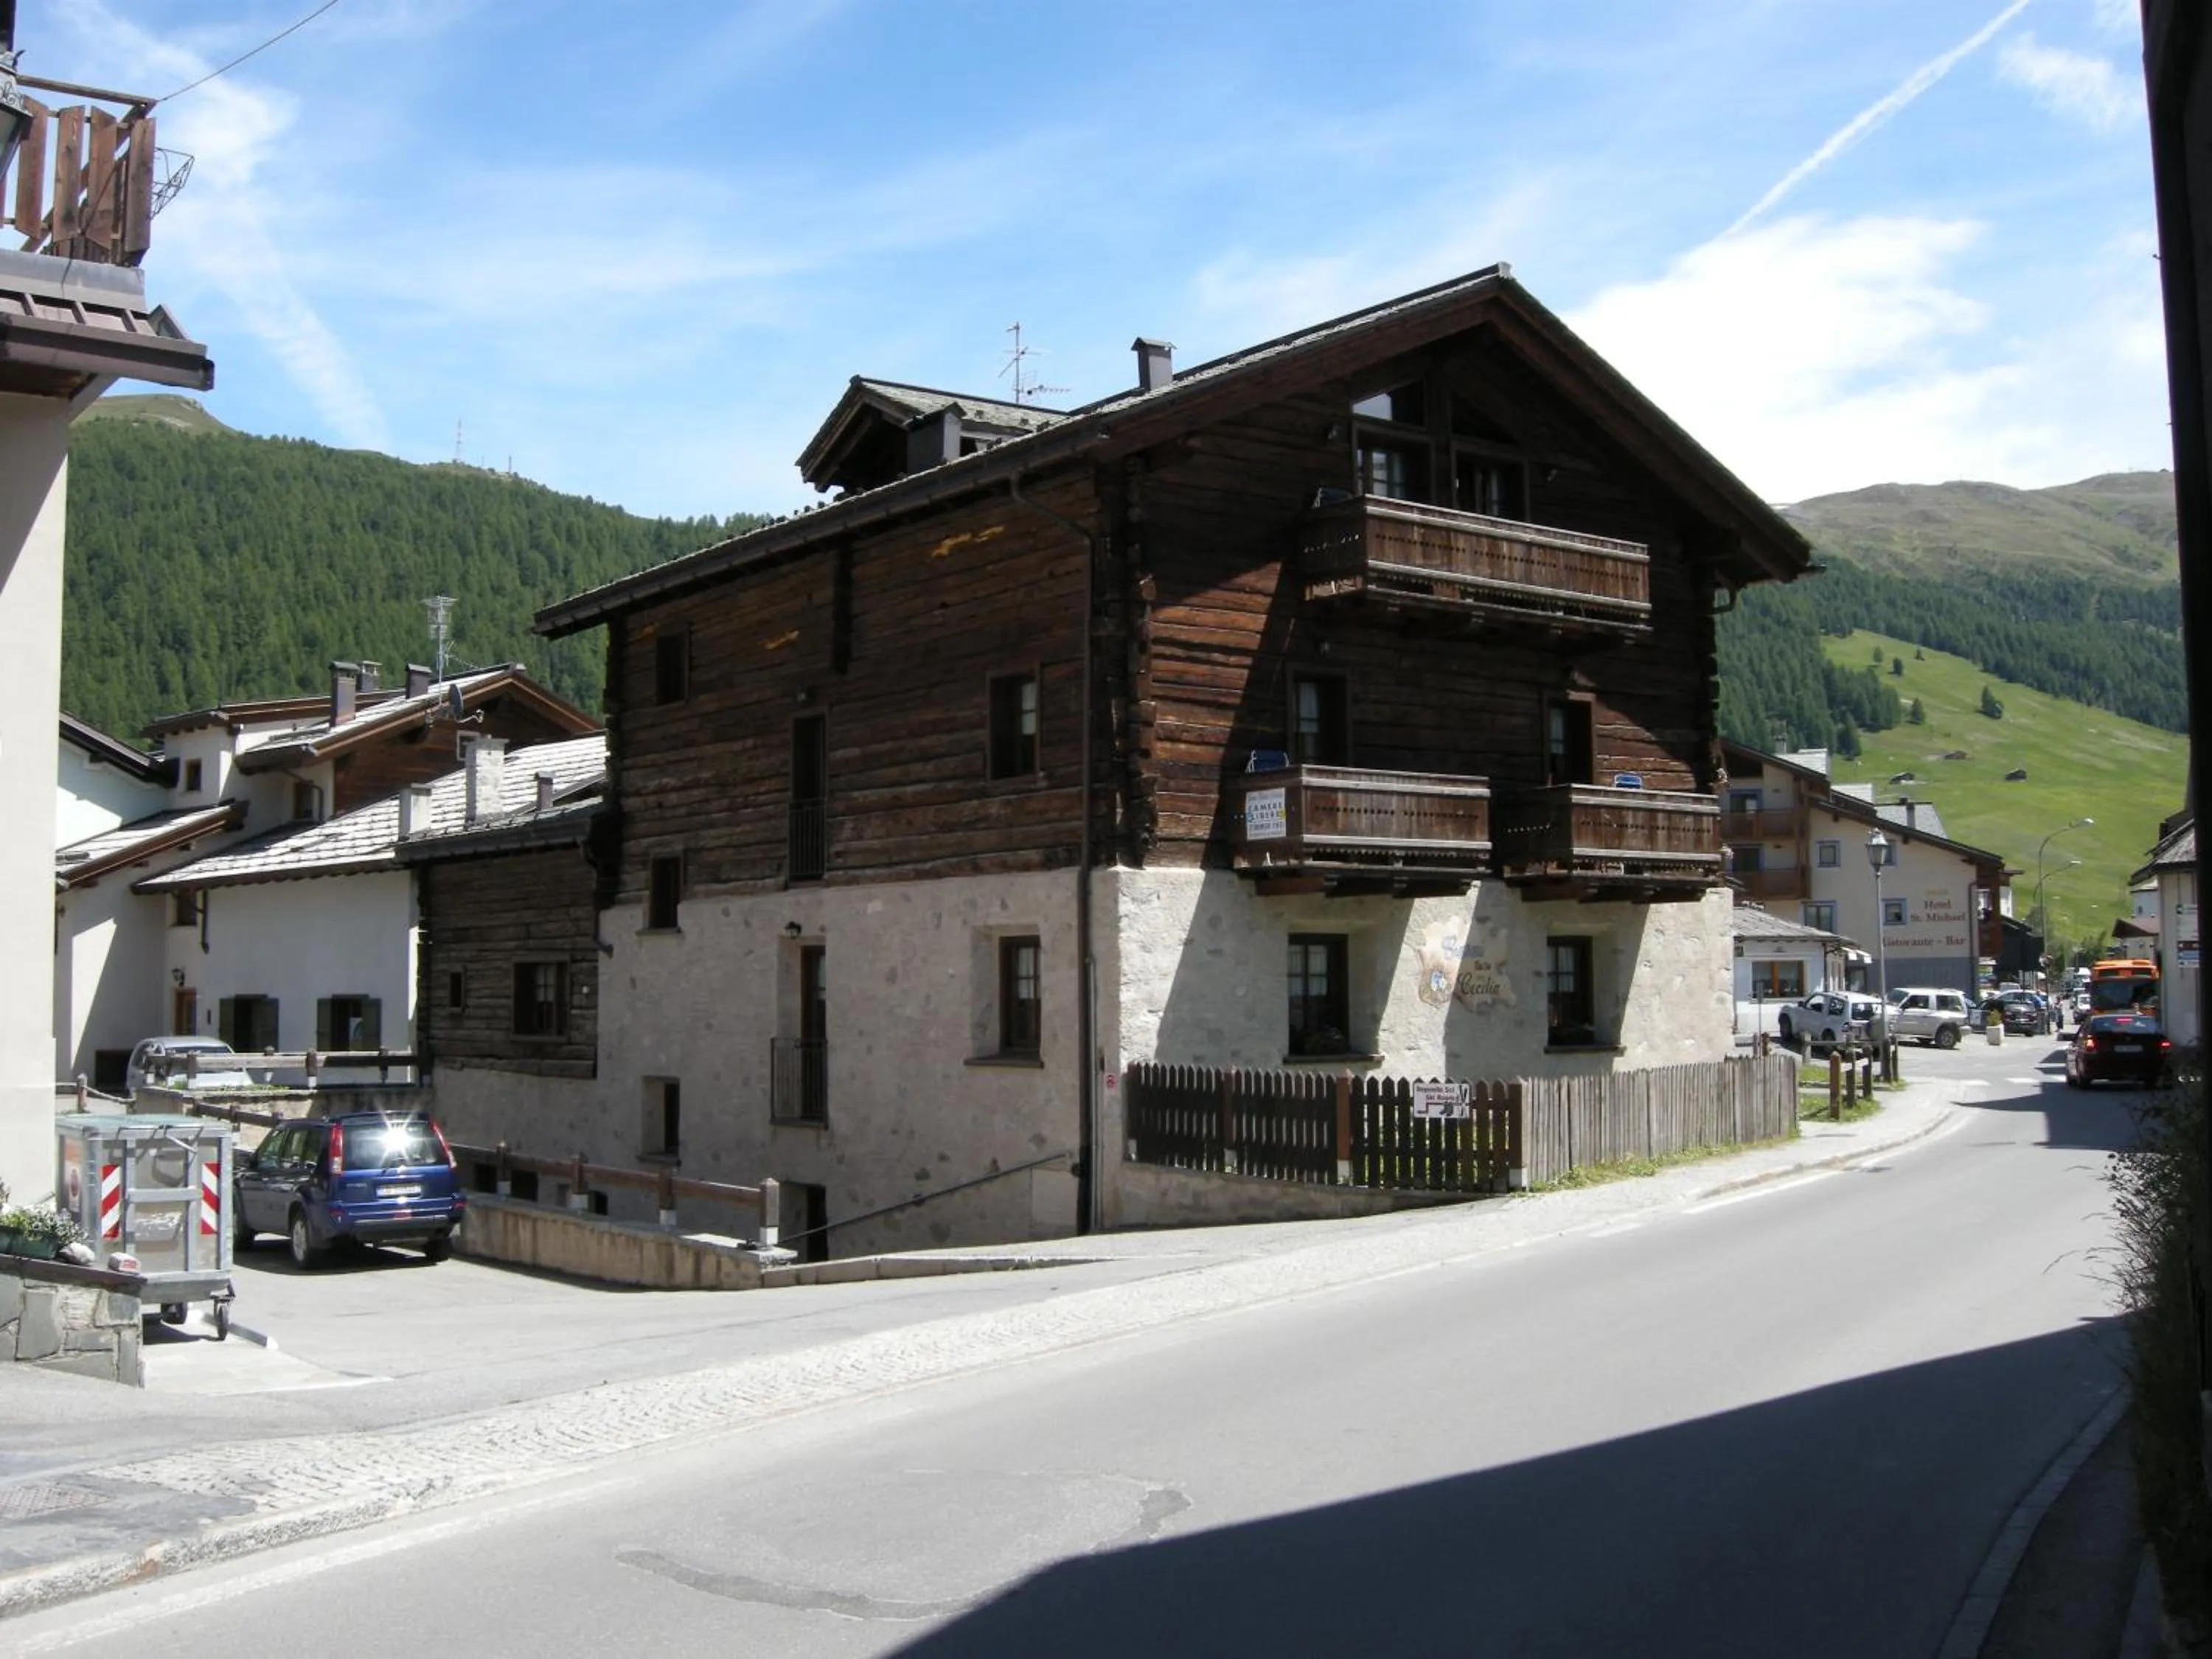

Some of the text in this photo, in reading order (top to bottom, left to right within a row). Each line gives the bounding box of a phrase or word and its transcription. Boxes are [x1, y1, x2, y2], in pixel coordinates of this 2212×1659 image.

[1924, 899, 1952, 909] Hotel
[1925, 910, 1966, 921] Michael
[1944, 934, 1965, 945] Bar
[1458, 972, 1500, 995] Cecilia
